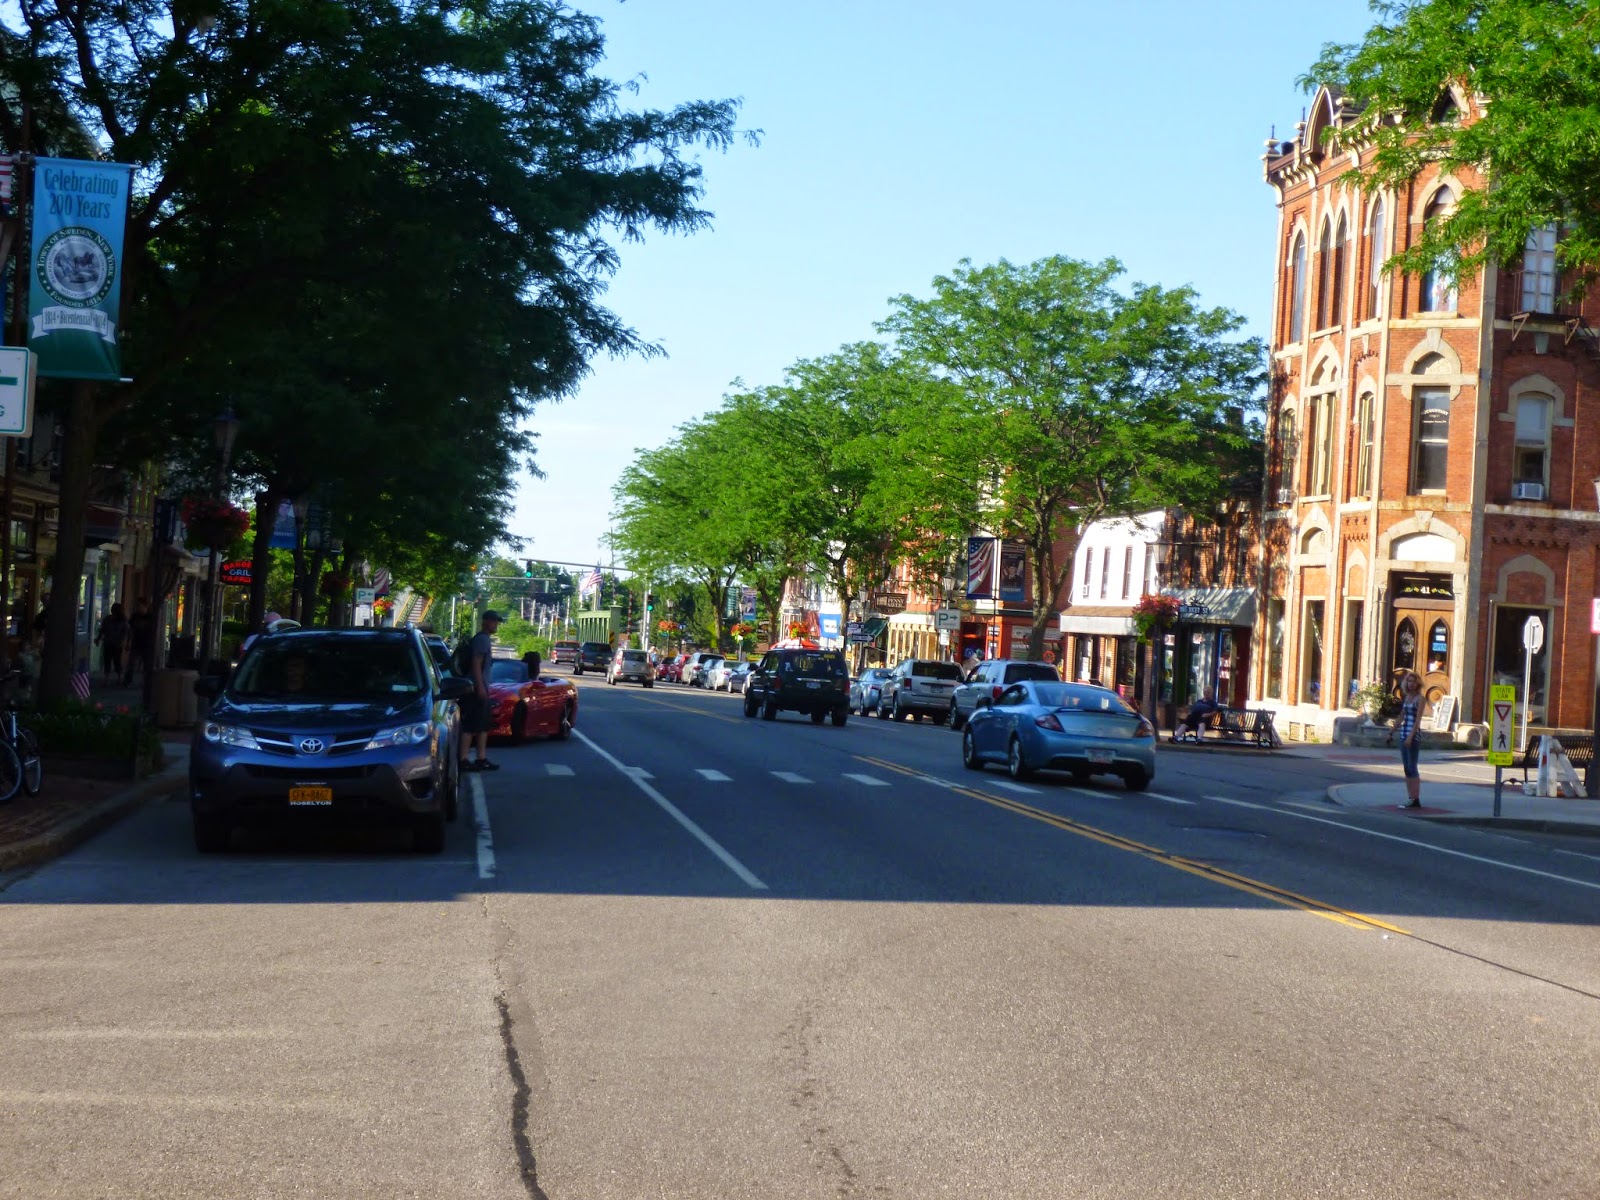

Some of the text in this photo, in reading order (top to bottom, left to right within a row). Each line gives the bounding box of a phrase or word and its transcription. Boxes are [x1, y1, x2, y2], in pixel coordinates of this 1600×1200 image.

[45, 168, 118, 198] Celebrating
[50, 193, 110, 218] 200 Years
[50, 291, 102, 307] FOUNDED 1814
[223, 561, 253, 571] BARBE
[222, 575, 251, 583] TAPRO
[358, 590, 366, 600] P
[1421, 586, 1430, 594] 41
[938, 613, 949, 626] P
